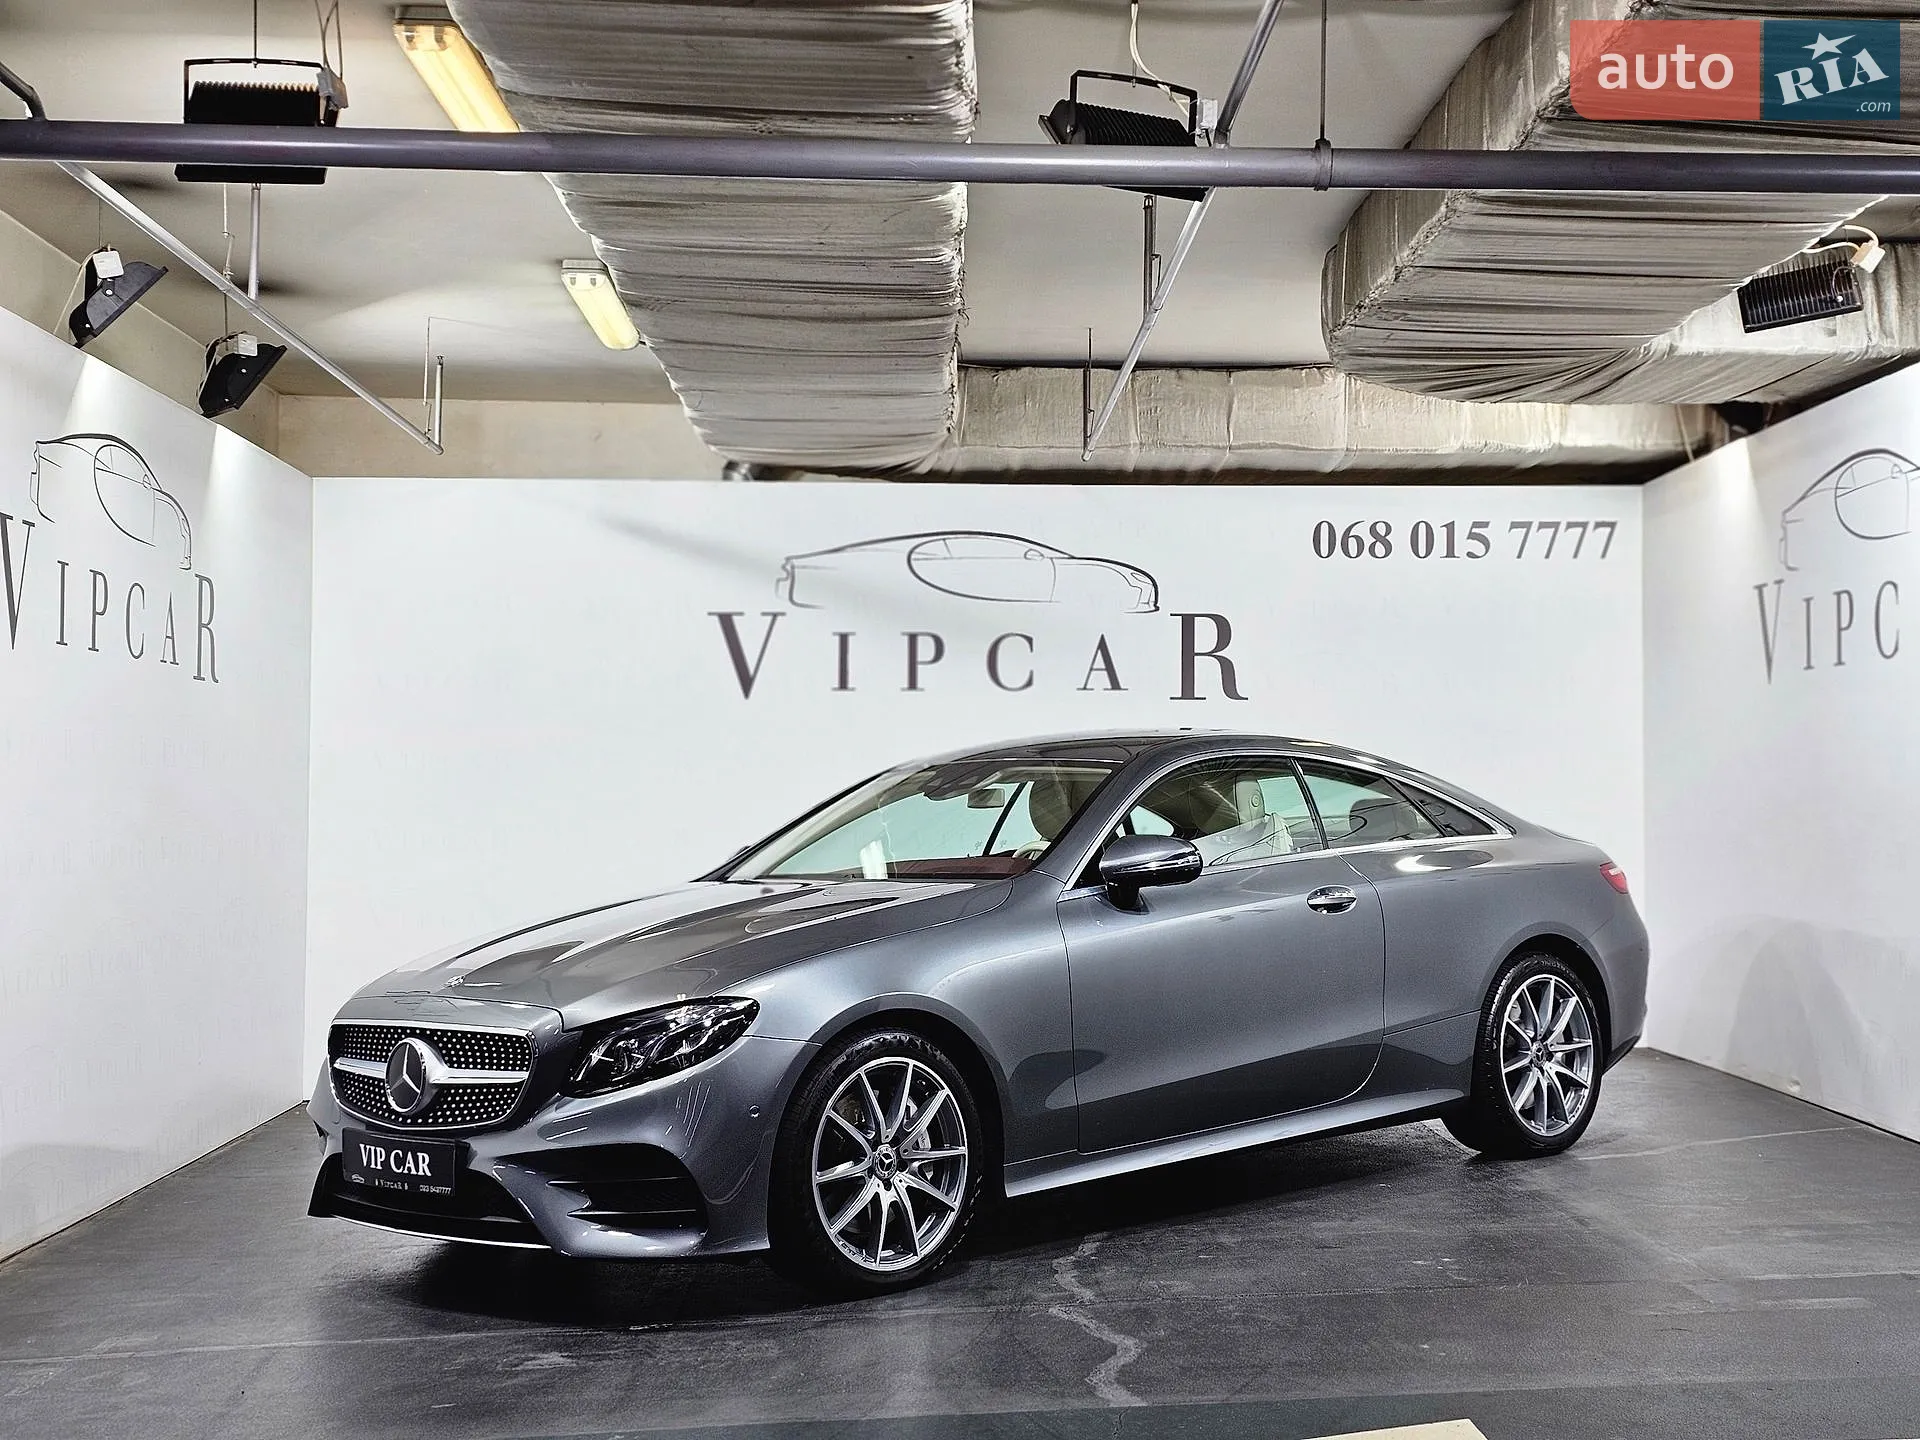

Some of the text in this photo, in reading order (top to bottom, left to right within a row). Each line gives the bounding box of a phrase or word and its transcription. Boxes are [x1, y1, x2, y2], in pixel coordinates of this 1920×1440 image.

[1312, 520, 1618, 560] 068 015 7777
[0, 512, 219, 683] VIPCAR
[707, 612, 1249, 701] VIPCAR
[359, 1143, 432, 1176] VIP CAR
